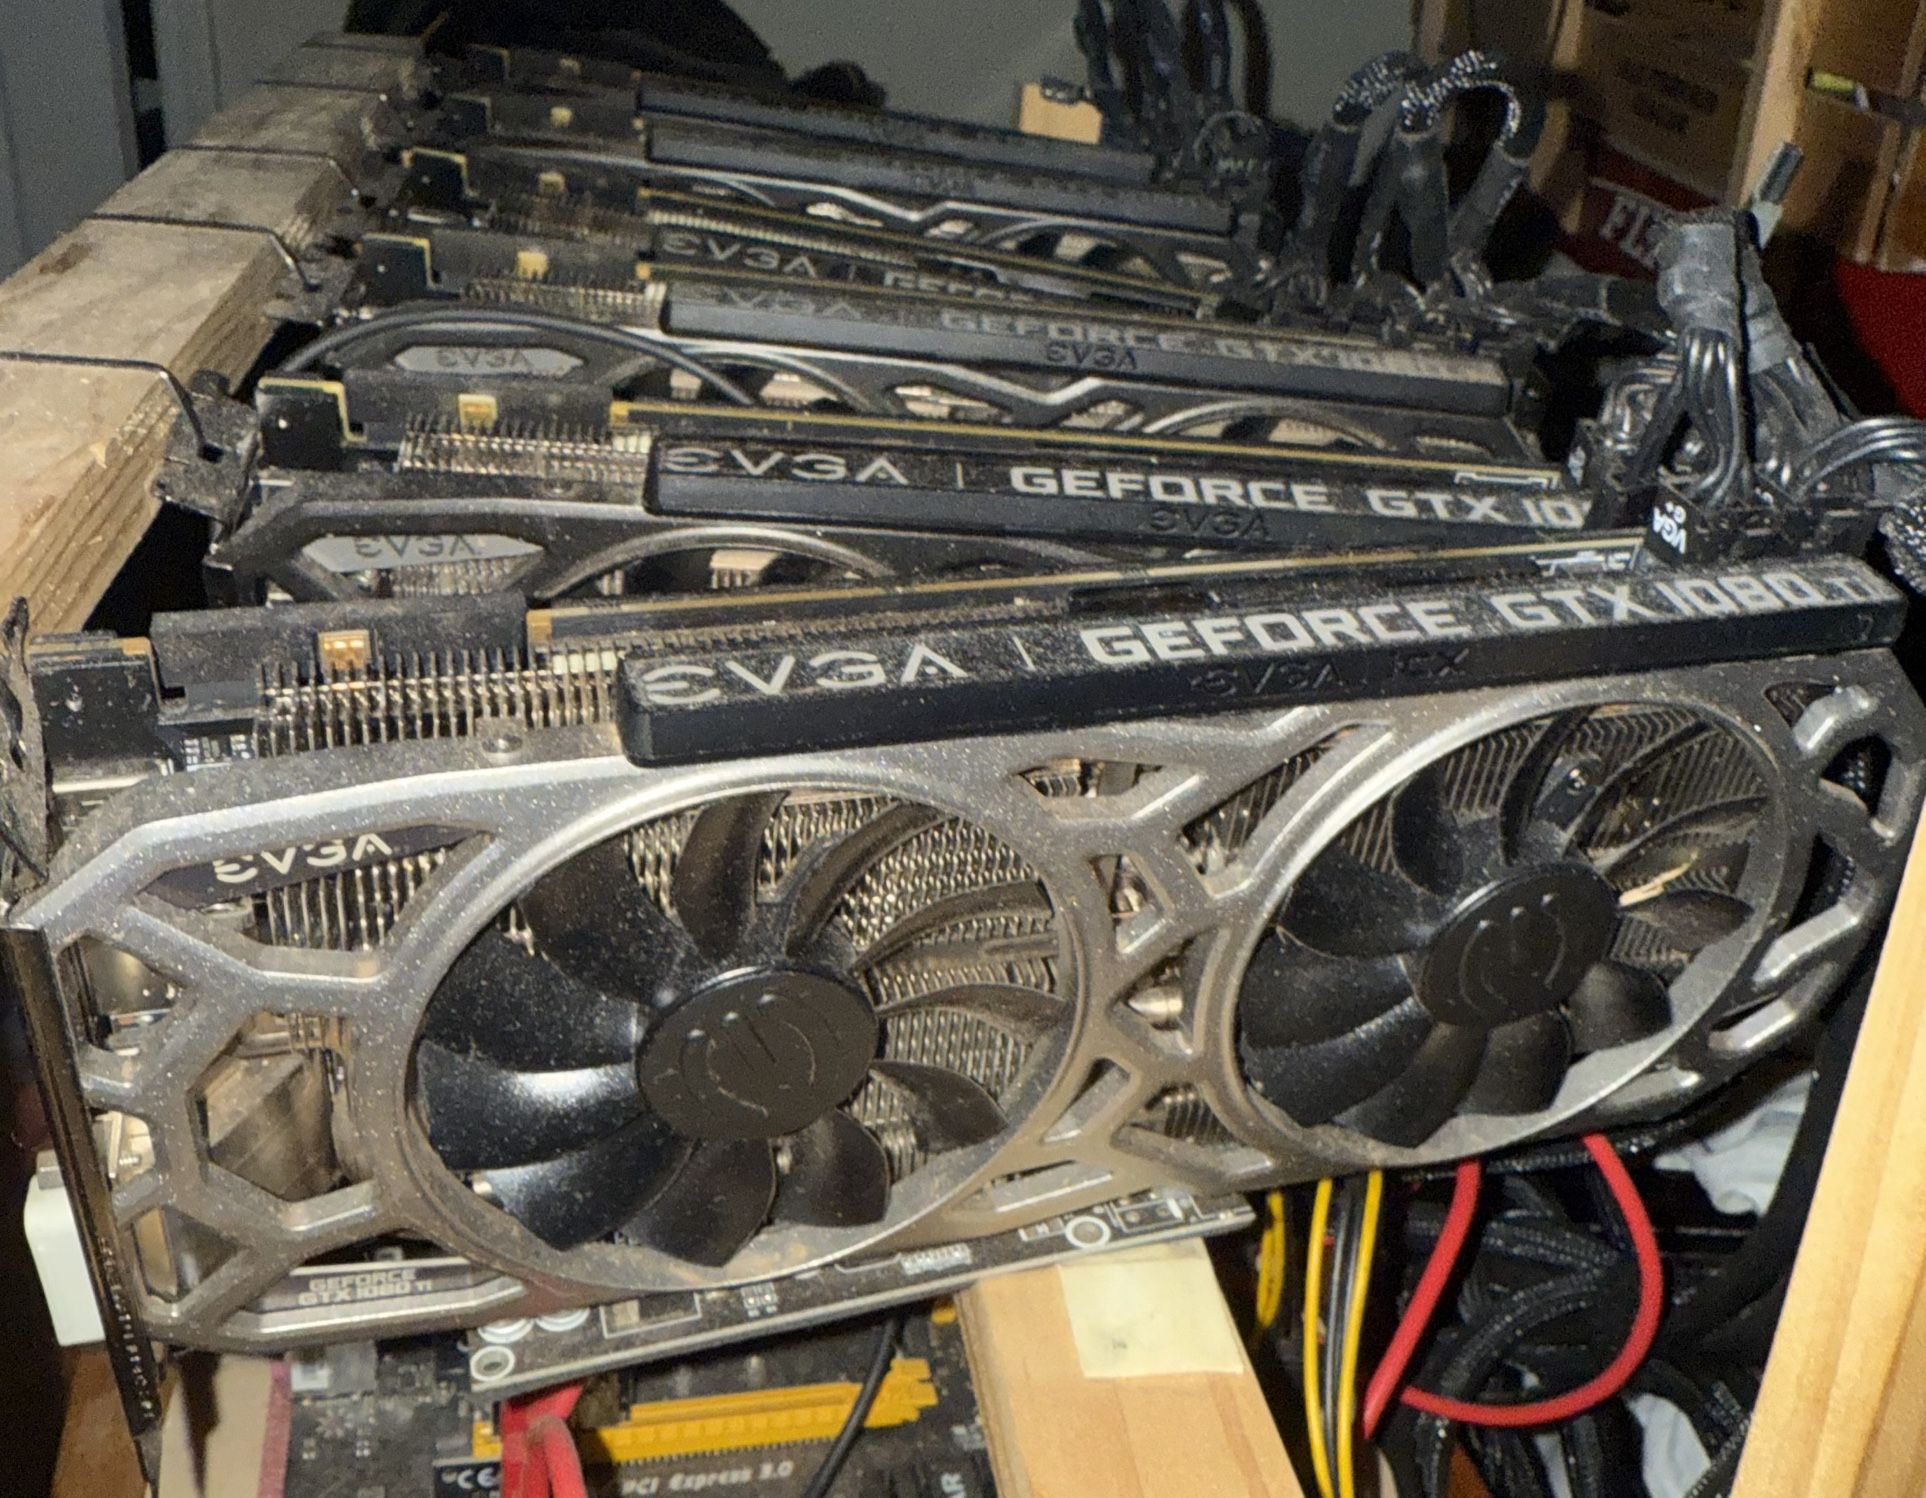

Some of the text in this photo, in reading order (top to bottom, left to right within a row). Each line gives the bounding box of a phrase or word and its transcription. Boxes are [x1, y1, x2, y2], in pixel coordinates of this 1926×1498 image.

[662, 231, 818, 278] EVGA
[436, 349, 535, 369] EVGA
[1046, 340, 1138, 371] EVGA
[663, 446, 909, 486] EVGA
[1009, 466, 1337, 513] GEFORCE
[1365, 489, 1507, 523] GTX
[1150, 506, 1271, 541] EVGA
[353, 534, 476, 557] EVGA
[640, 642, 968, 705] EVGA
[1080, 600, 1472, 665] GEFORCE
[1489, 584, 1660, 629] GTX
[1654, 571, 1825, 618] 1080
[212, 833, 393, 884] EVGA
[308, 1268, 417, 1292] GEFORCE
[298, 1290, 352, 1306] GTX
[668, 1467, 752, 1491] Express
